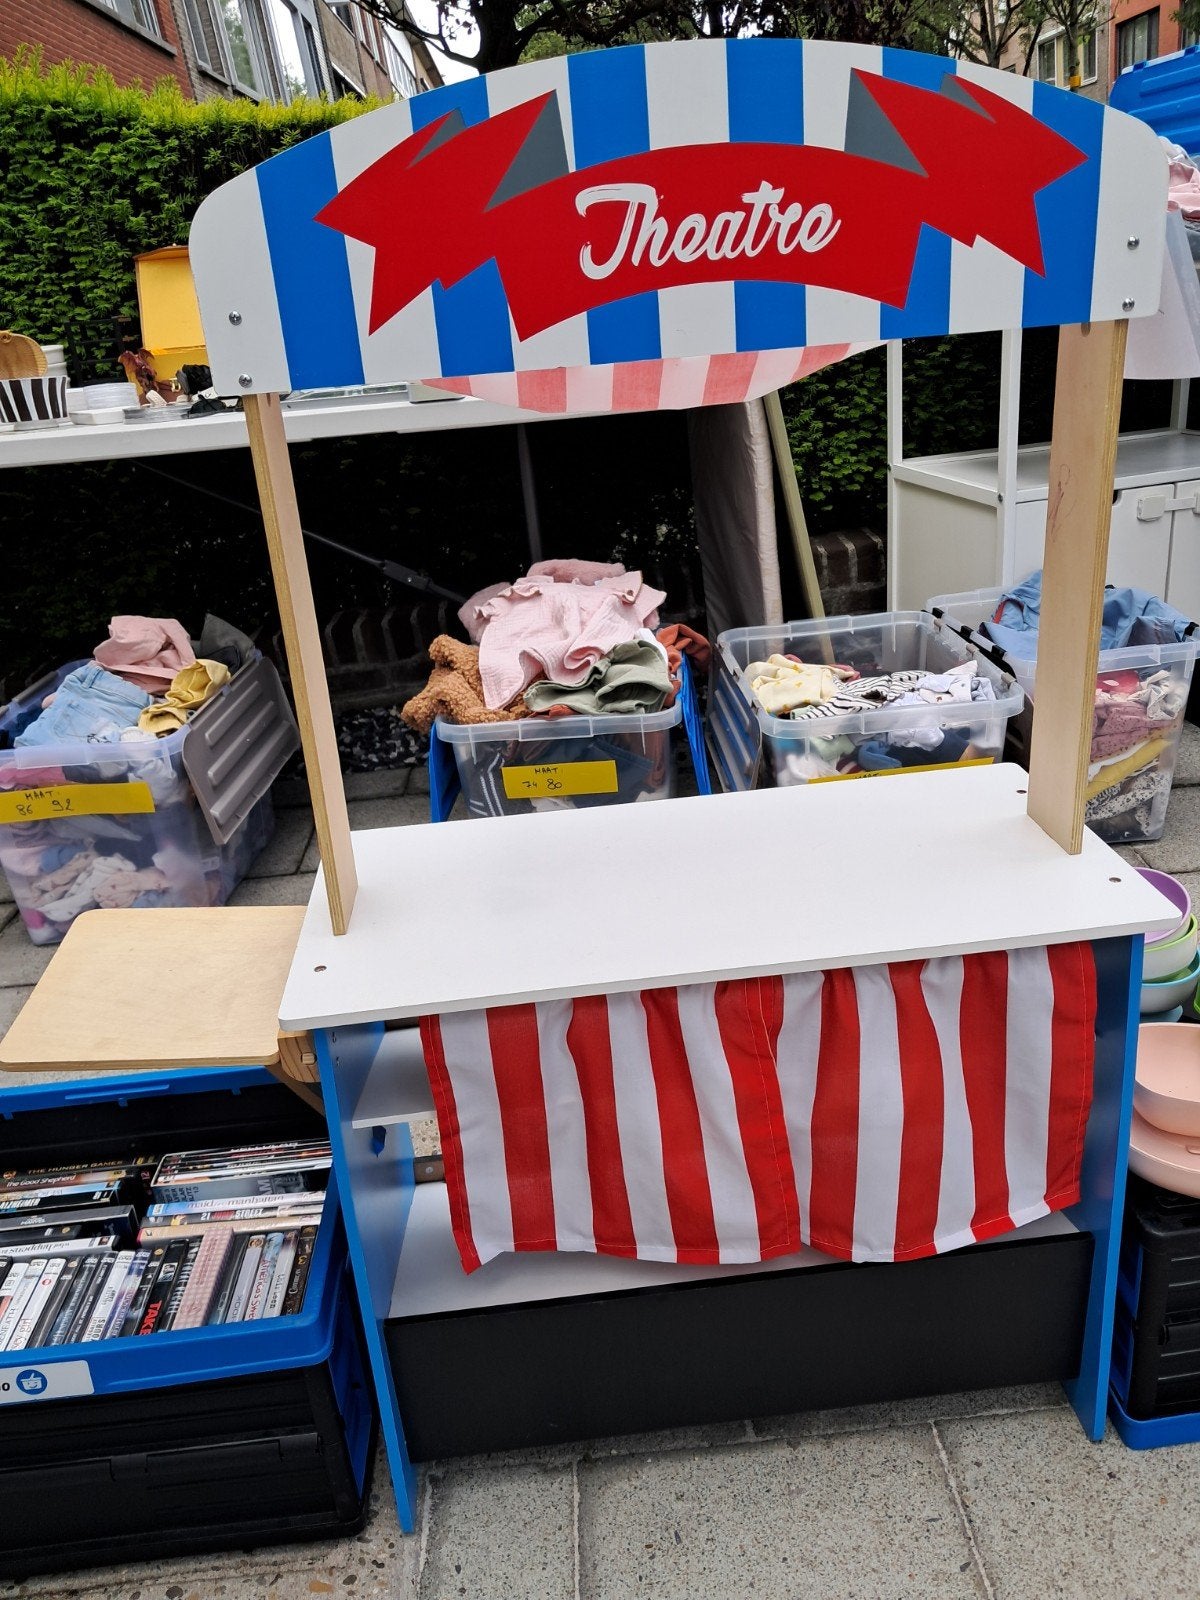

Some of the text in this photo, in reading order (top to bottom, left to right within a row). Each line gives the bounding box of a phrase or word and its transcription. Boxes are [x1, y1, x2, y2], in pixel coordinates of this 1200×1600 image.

[575, 180, 841, 280] Theatre
[546, 778, 563, 790] 80
[16, 798, 74, 816] 86 92
[47, 1163, 89, 1173] HUNGER
[90, 1160, 124, 1169] GAMES
[20, 1178, 40, 1186] Good
[39, 1173, 77, 1185] Shepherd
[187, 1199, 213, 1209] maid
[227, 1196, 285, 1207] manhattan
[200, 1212, 211, 1221] 21
[235, 1208, 265, 1219] STREET
